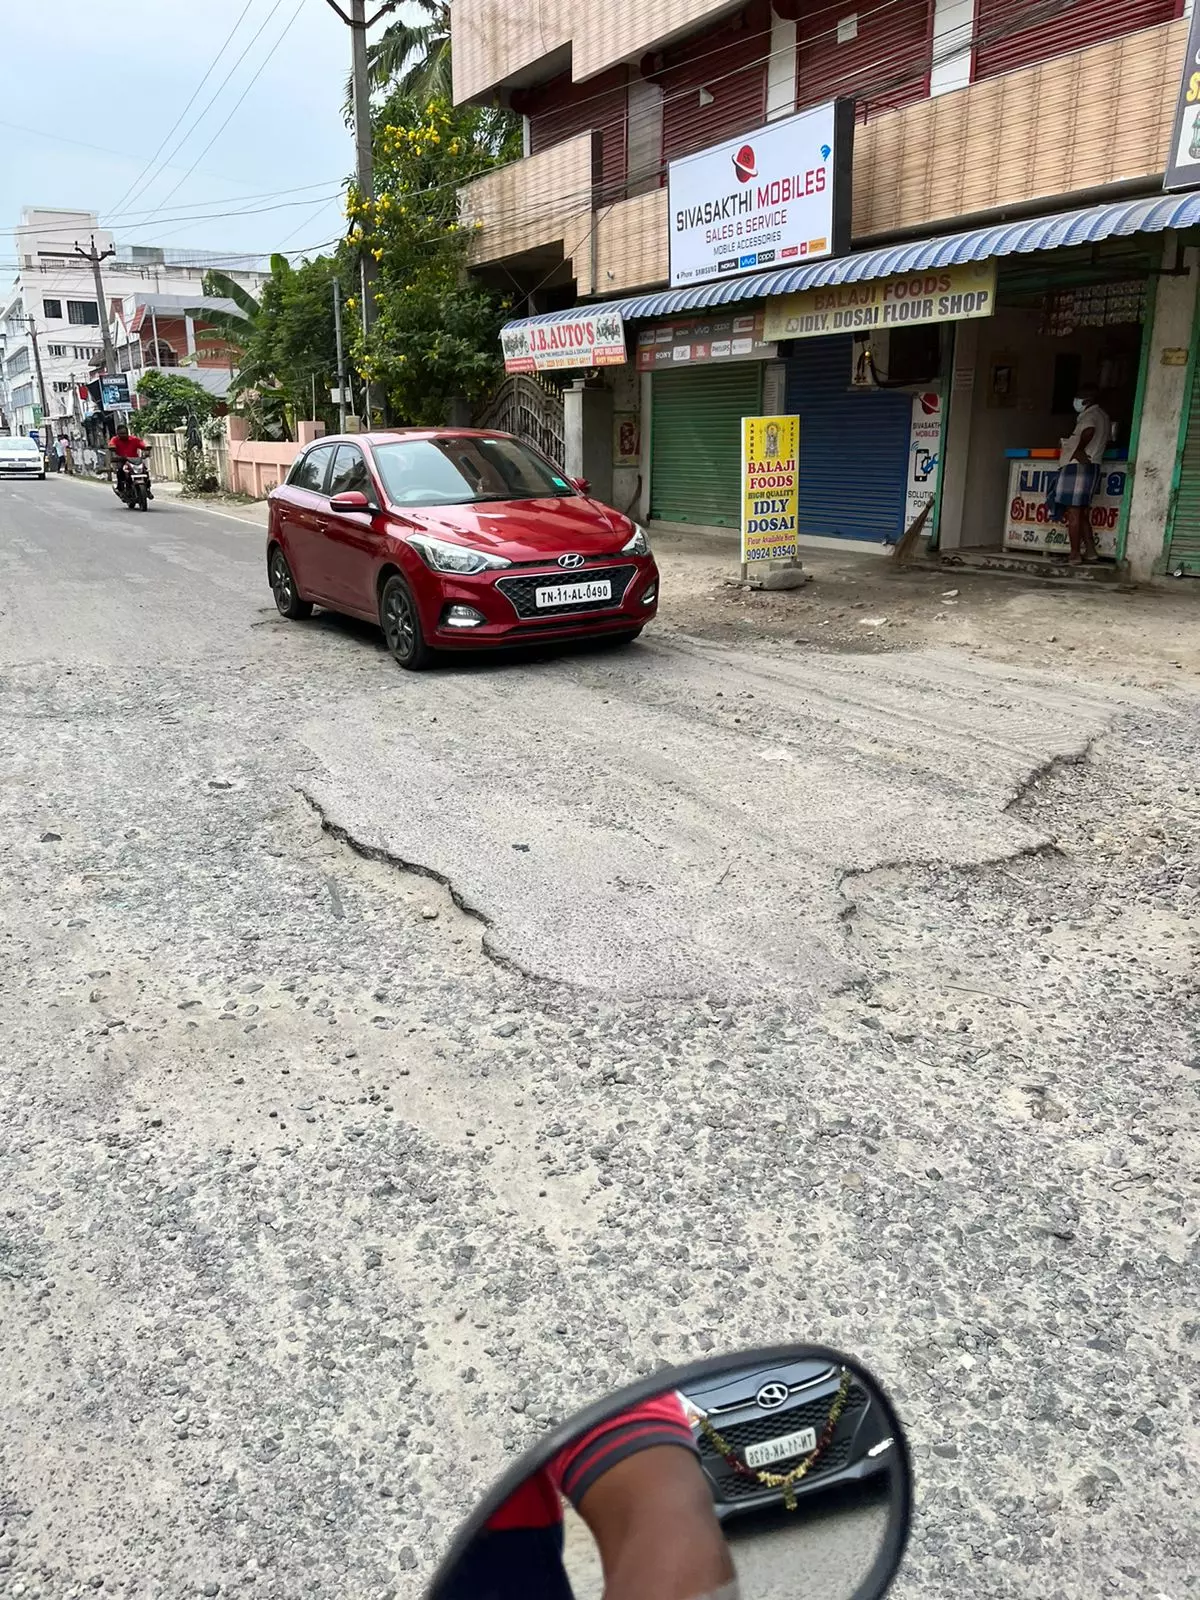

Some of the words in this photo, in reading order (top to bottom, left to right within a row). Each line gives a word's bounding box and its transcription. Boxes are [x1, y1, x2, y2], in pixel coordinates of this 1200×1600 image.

[676, 189, 752, 232] SIVASAKTHI
[757, 167, 826, 209] MOBILES
[705, 224, 734, 244] SALES
[737, 221, 743, 235] &
[746, 209, 788, 234] SERVICE
[713, 241, 736, 256] MOBILE
[737, 231, 782, 250] ACCESSORIES
[814, 286, 876, 311] BALAJI
[883, 274, 952, 301] FOODS
[799, 313, 829, 333] IDLY,
[833, 306, 879, 329] DOSAI
[883, 298, 933, 325] FLOUR
[938, 290, 989, 316] SHOP
[530, 321, 595, 352] J.B.AUTO'S
[655, 350, 672, 360] SONY
[913, 421, 942, 430] SIVASAKTH
[915, 430, 939, 438] MOBILES
[747, 459, 796, 474] BALAJI
[750, 475, 793, 490] FOODS
[748, 491, 765, 499] HIGH
[766, 489, 794, 499] QUALITY
[908, 490, 936, 499] SOLUTIO
[753, 498, 790, 515] IDLY
[747, 515, 796, 534] DOSAI
[748, 537, 761, 545] Flour
[763, 534, 784, 543] Available
[746, 547, 770, 560] 90924
[772, 544, 796, 558] 93540
[541, 584, 608, 603] TN-11-AL-0490
